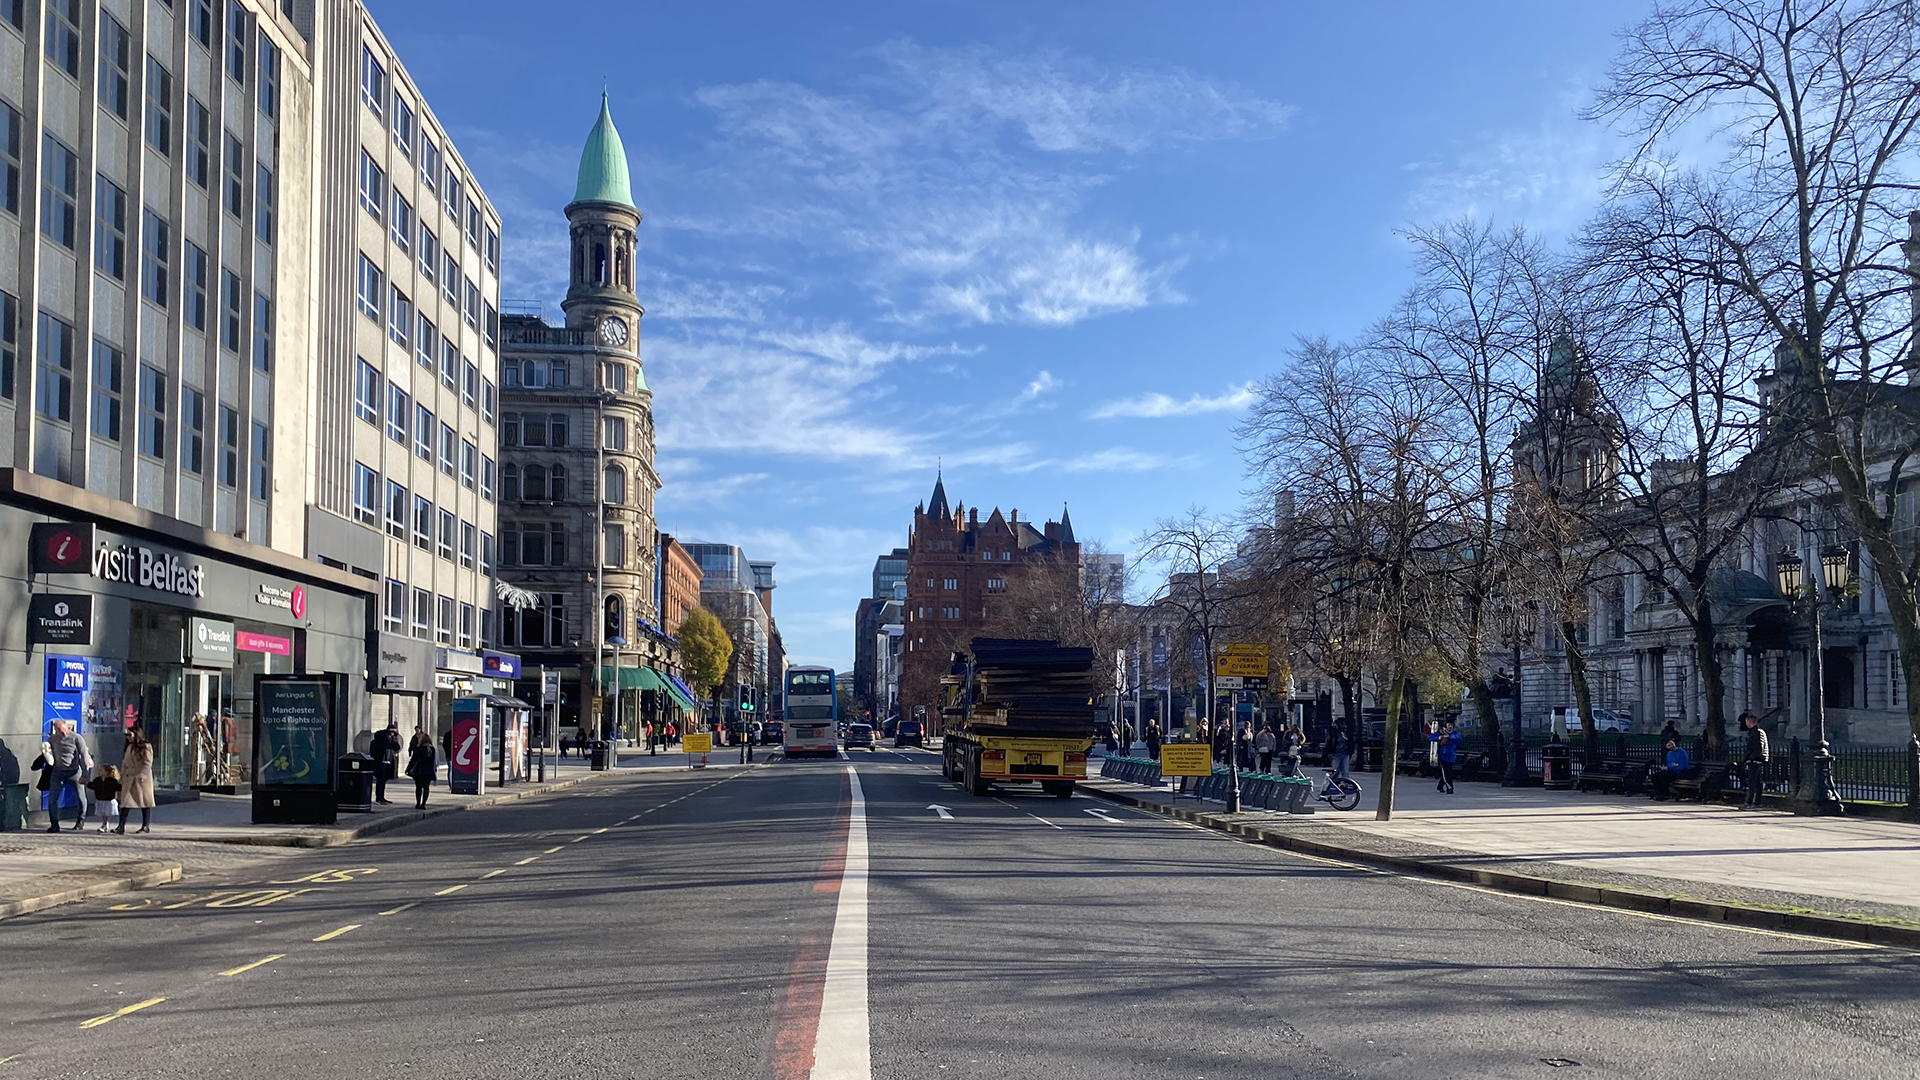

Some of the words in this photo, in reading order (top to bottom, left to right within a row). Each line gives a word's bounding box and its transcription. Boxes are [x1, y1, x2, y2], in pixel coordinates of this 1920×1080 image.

[139, 547, 205, 598] Belfast
[38, 617, 83, 627] Translink
[207, 628, 231, 643] Translink
[66, 661, 85, 671] PIVOTAL
[62, 672, 84, 688] ATM
[271, 706, 315, 714] Manchester
[287, 715, 310, 724] flights
[311, 716, 328, 724] daily
